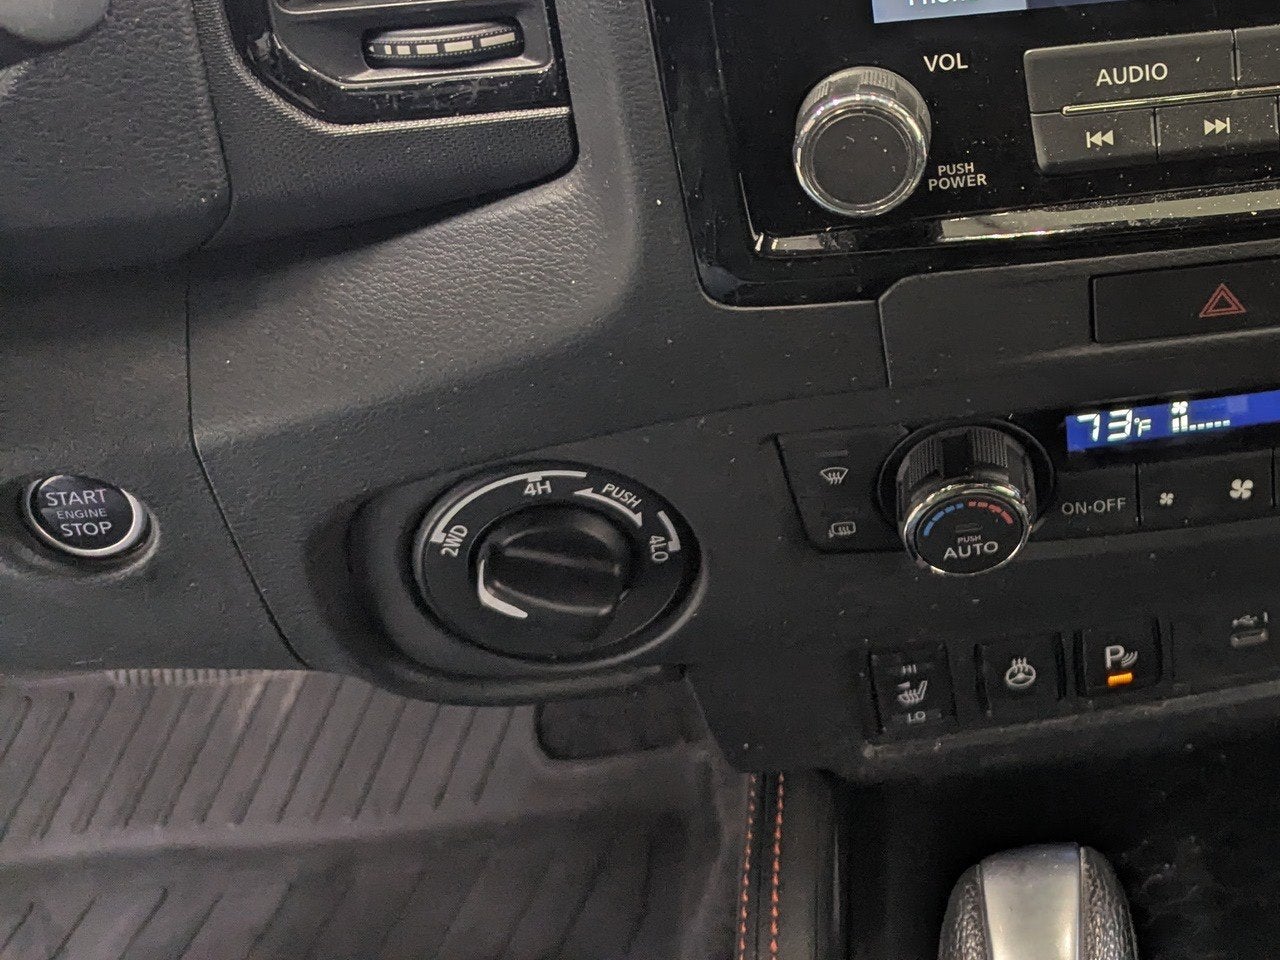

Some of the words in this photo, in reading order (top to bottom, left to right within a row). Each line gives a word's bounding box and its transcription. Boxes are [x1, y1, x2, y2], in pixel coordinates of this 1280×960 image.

[923, 51, 969, 73] VOL
[1096, 62, 1169, 87] AUDIO
[937, 162, 975, 176] PUSH
[928, 172, 988, 191] POWER
[44, 487, 108, 507] START
[524, 480, 552, 496] 4H
[602, 482, 643, 508] PUSH
[56, 506, 108, 520] ENGINE
[60, 520, 112, 538] STOP
[440, 524, 468, 558] 2WD
[650, 534, 670, 564] 4LO
[956, 534, 982, 545] PUSH
[942, 540, 999, 561] AUTO
[907, 710, 927, 724] LO
